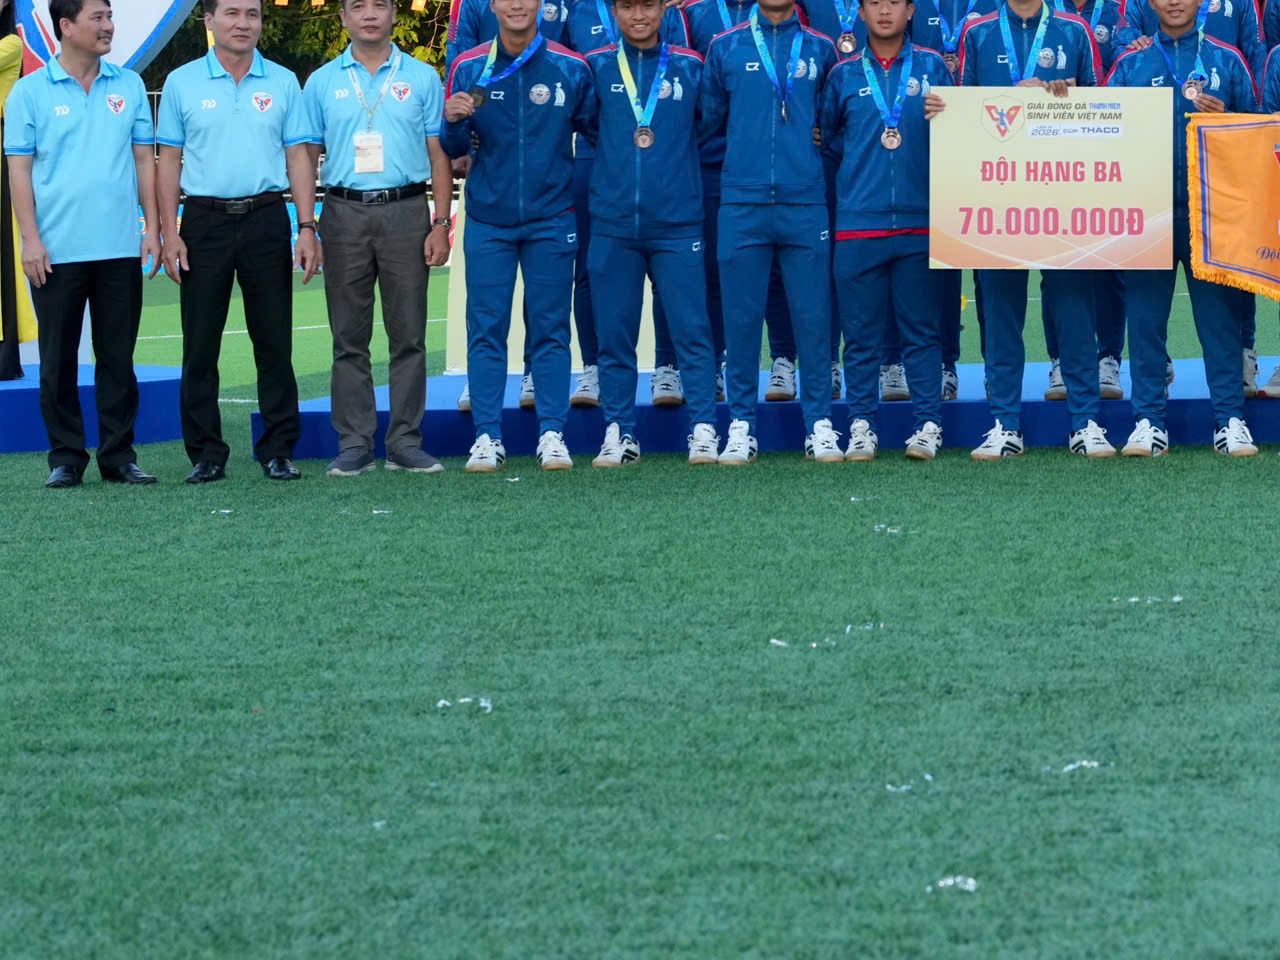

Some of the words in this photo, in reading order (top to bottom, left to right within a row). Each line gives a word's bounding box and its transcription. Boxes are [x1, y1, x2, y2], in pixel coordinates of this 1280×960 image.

[1026, 112, 1050, 120] SINH
[1053, 110, 1074, 120] VIÊN
[1078, 110, 1097, 121] VIỆT
[1099, 112, 1122, 120] NAM
[981, 156, 1016, 186] ĐỘI
[1026, 161, 1086, 186] HẠNG
[1094, 161, 1122, 182] BA
[958, 207, 1144, 236] 70.000.000Đ
